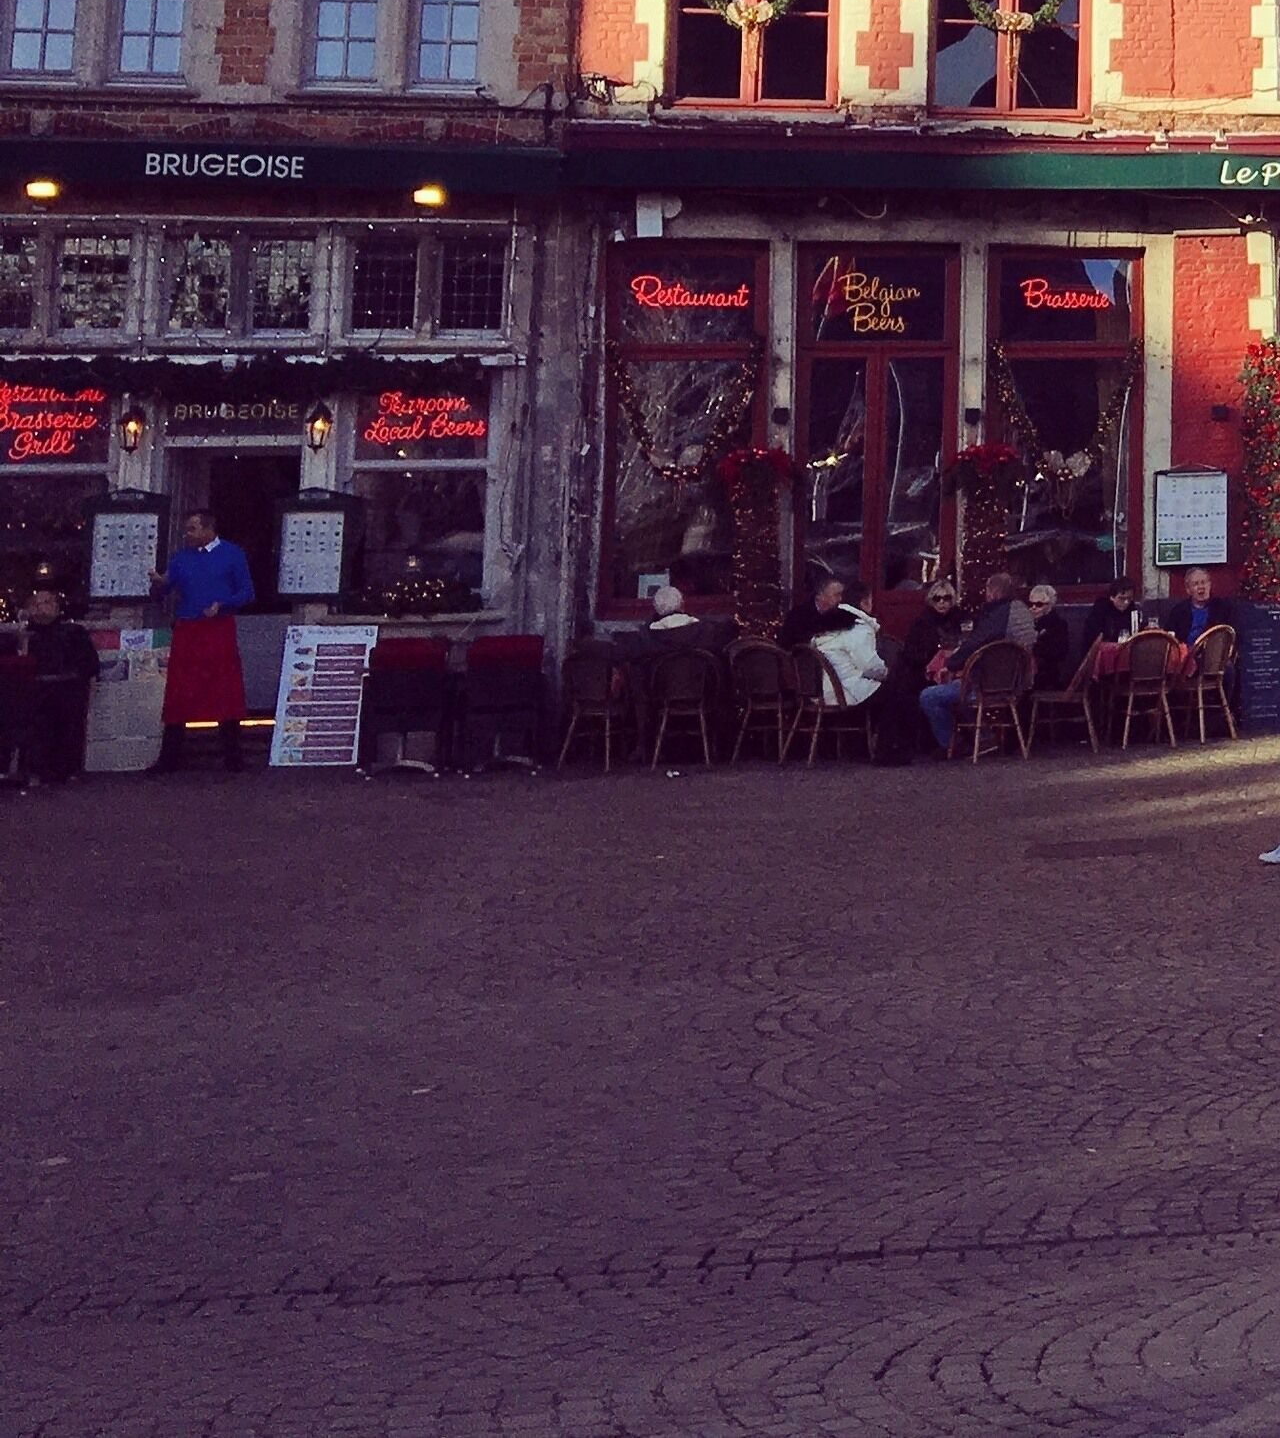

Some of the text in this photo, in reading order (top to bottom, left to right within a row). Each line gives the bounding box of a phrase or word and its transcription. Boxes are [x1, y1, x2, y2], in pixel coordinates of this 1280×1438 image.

[145, 153, 305, 179] BRUGEOISE
[1220, 160, 1258, 185] Le
[631, 275, 750, 307] Restaurant
[838, 272, 921, 318] Belgian
[1020, 278, 1110, 308] Brasserie
[847, 302, 906, 333] Beers
[174, 403, 299, 420] BRUGEOISE
[379, 391, 472, 416] Tearoom
[365, 412, 486, 444] Local Beers
[9, 430, 75, 460] Grill
